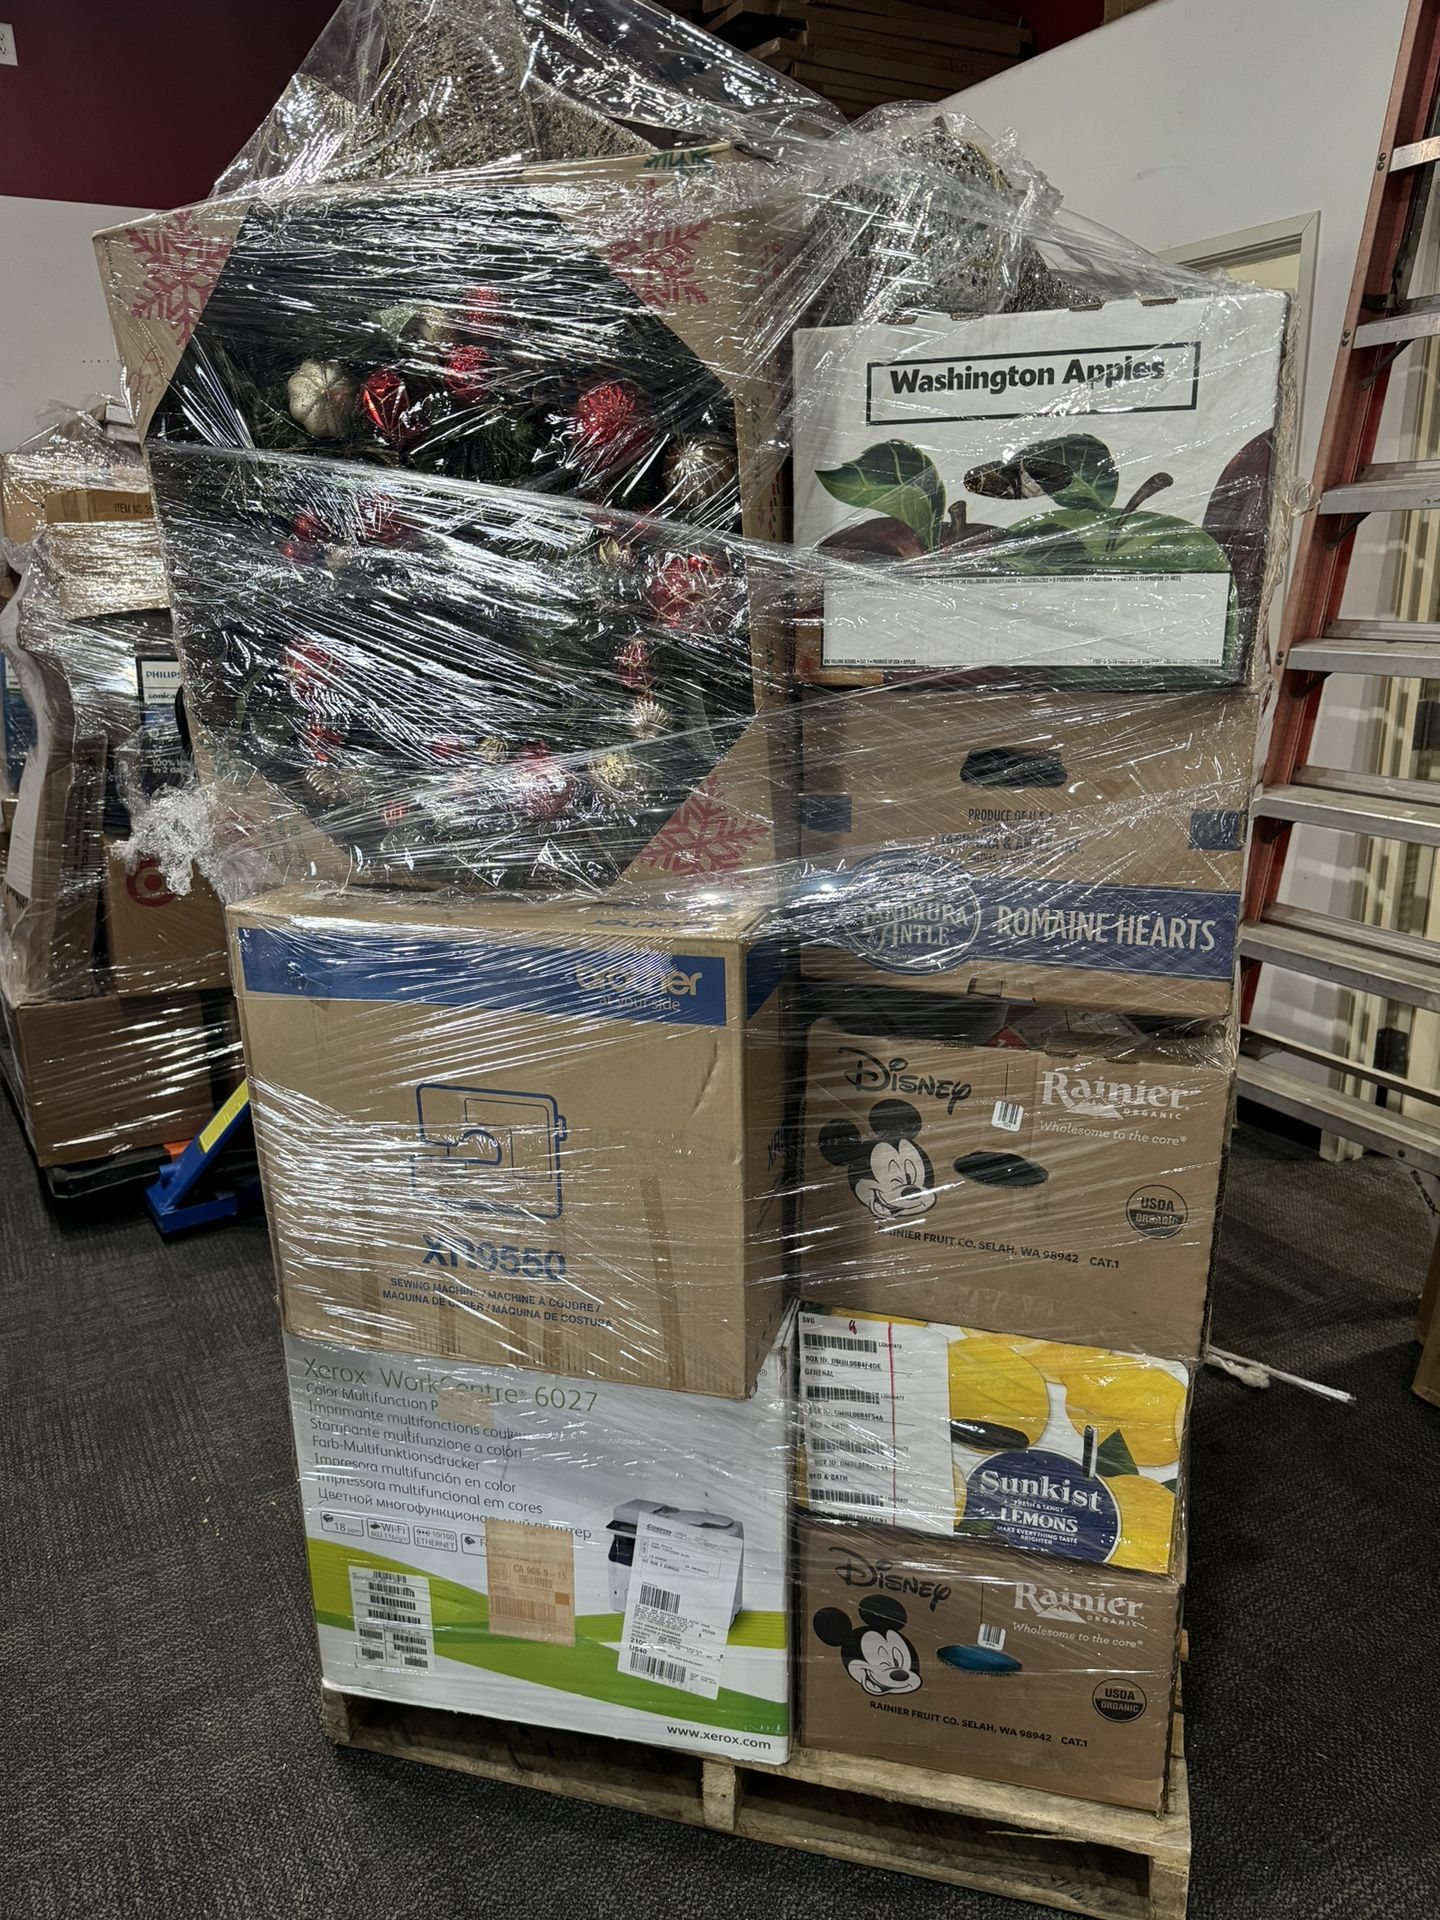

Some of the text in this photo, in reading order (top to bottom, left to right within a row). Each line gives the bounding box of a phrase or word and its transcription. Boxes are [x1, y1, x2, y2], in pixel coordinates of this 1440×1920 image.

[890, 356, 1165, 396] Washington Apples
[114, 503, 130, 513] ITEM
[968, 809, 1012, 821] PRODUCE
[878, 923, 950, 952] ANTLE
[998, 905, 1216, 950] ROMAINE HEARTS
[576, 962, 702, 996] broer
[618, 999, 647, 1010] your
[652, 998, 680, 1010] side
[838, 1047, 972, 1115] Disney
[1041, 1071, 1187, 1110] Rainier
[1124, 1108, 1182, 1120] ORGANIC
[1040, 1121, 1109, 1140] Wholesome
[1113, 1130, 1126, 1140] to
[1129, 1130, 1149, 1143] the
[1140, 1197, 1175, 1212] USDA
[422, 1233, 567, 1281] XR9550
[923, 1233, 955, 1246] FRUIT
[958, 1238, 977, 1249] CO.
[978, 1241, 1017, 1256] SELAH,
[1020, 1246, 1041, 1259] WA
[1043, 1249, 1079, 1263] 98942
[1089, 1256, 1120, 1269] CAT.1
[390, 1277, 431, 1291] SEWING
[488, 1291, 535, 1305] MACHINE
[549, 1299, 594, 1313] COUDRE
[431, 1296, 445, 1307] DE
[544, 1312, 558, 1322] DE
[561, 1314, 613, 1329] COSTURA
[804, 1369, 834, 1377] GENERAL
[306, 1382, 338, 1397] Color
[342, 1387, 423, 1410] Multifunction
[379, 1367, 518, 1404] Workntre
[534, 1386, 598, 1412] 6027
[308, 1400, 383, 1422] Imprimante
[387, 1412, 480, 1436] multifonctions
[310, 1417, 523, 1459] Stampante multifunzione a colori
[312, 1435, 481, 1471] Farb-Multifunktionsdrucker
[314, 1452, 516, 1494] Impresora multifunción en color
[316, 1470, 543, 1515] Impressora multifuncional em cores
[980, 1470, 1102, 1513] Sunkist
[1013, 1499, 1035, 1509] FRESH
[1042, 1504, 1064, 1513] TANGY
[318, 1487, 373, 1506] Цветной
[376, 1497, 529, 1528] многофункциона
[1000, 1507, 1078, 1533] LEMONS
[335, 1522, 346, 1531] 18
[1017, 1528, 1058, 1541] EVERYTHING
[1020, 1535, 1052, 1545] BRIGHTER
[416, 1538, 454, 1549] ETHERNET
[828, 1547, 952, 1613] Disney
[1013, 1582, 1144, 1619] Rainier
[1012, 1622, 1076, 1640] Wholesome
[1079, 1631, 1090, 1640] to
[1093, 1631, 1113, 1644] the
[1087, 1615, 1138, 1627] ORGANIC
[1101, 1701, 1139, 1713] ORGANIC
[1104, 1688, 1135, 1701] USDA
[667, 1725, 771, 1750] www.xerox.com
[870, 1700, 1088, 1748] RAINIER FRUIT CO. SELAH, WA 98942 CAT.1
